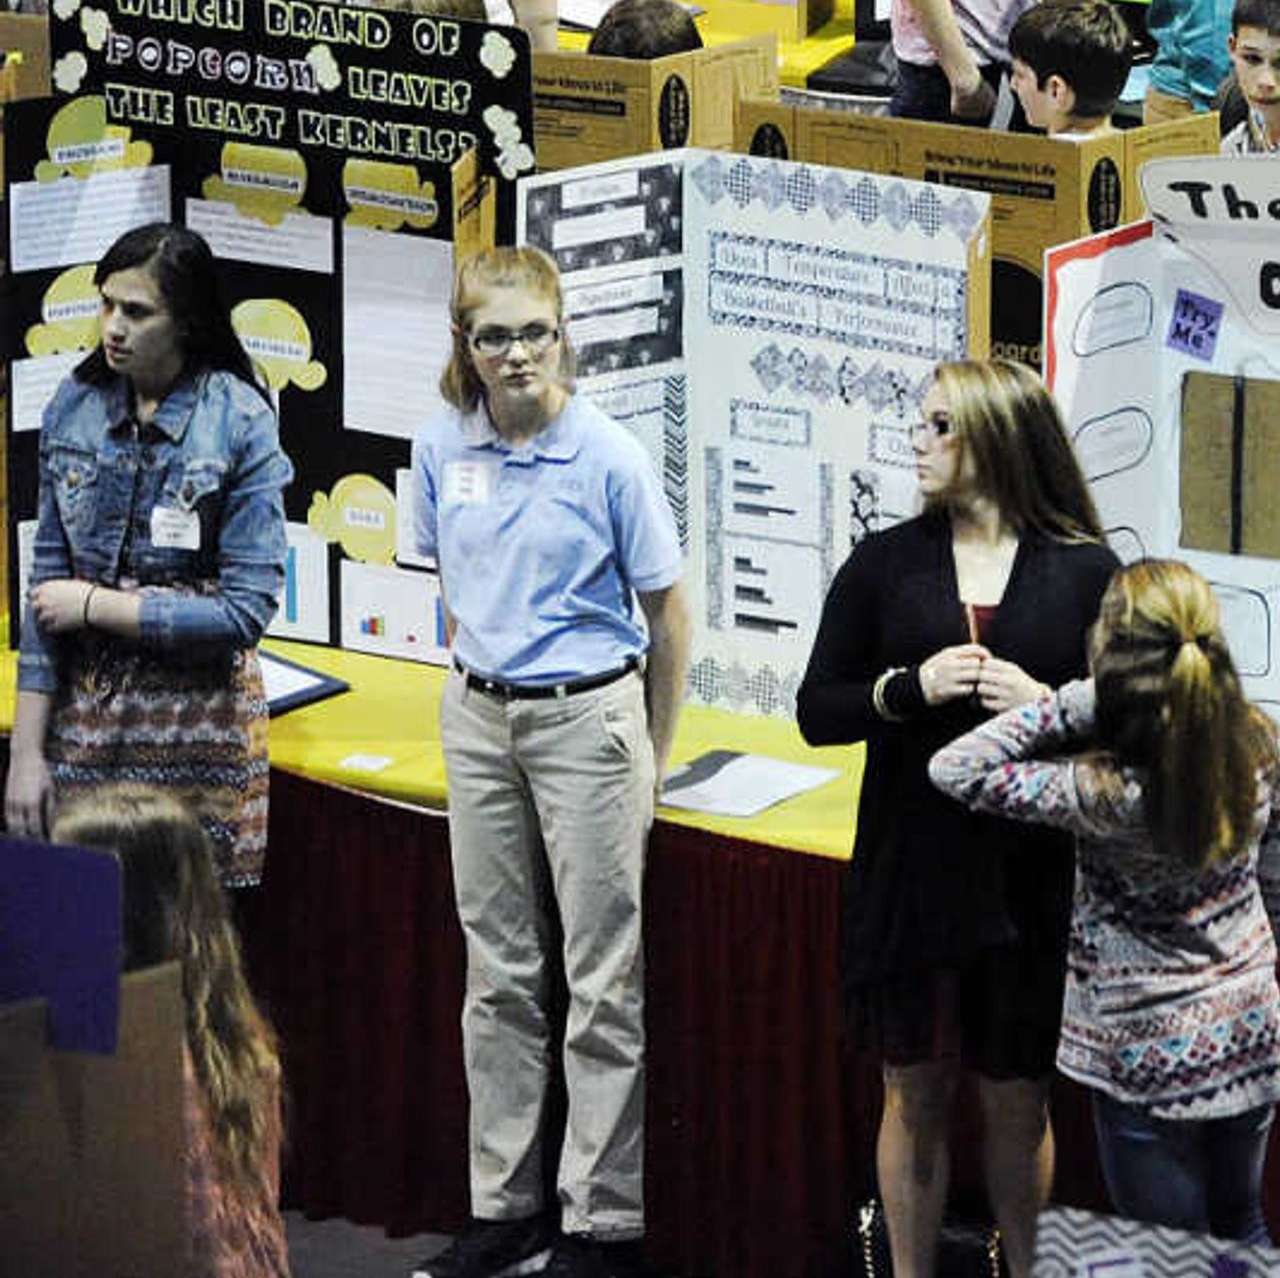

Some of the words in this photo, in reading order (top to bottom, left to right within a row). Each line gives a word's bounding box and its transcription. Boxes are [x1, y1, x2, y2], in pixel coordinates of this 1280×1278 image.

[265, 0, 389, 49] BRAND
[414, 20, 460, 56] OF
[105, 34, 320, 96] POPCORN
[348, 67, 471, 115] LEAVES
[105, 85, 174, 124] THE
[187, 96, 285, 140] LEAST
[300, 111, 477, 163] KERNELS?
